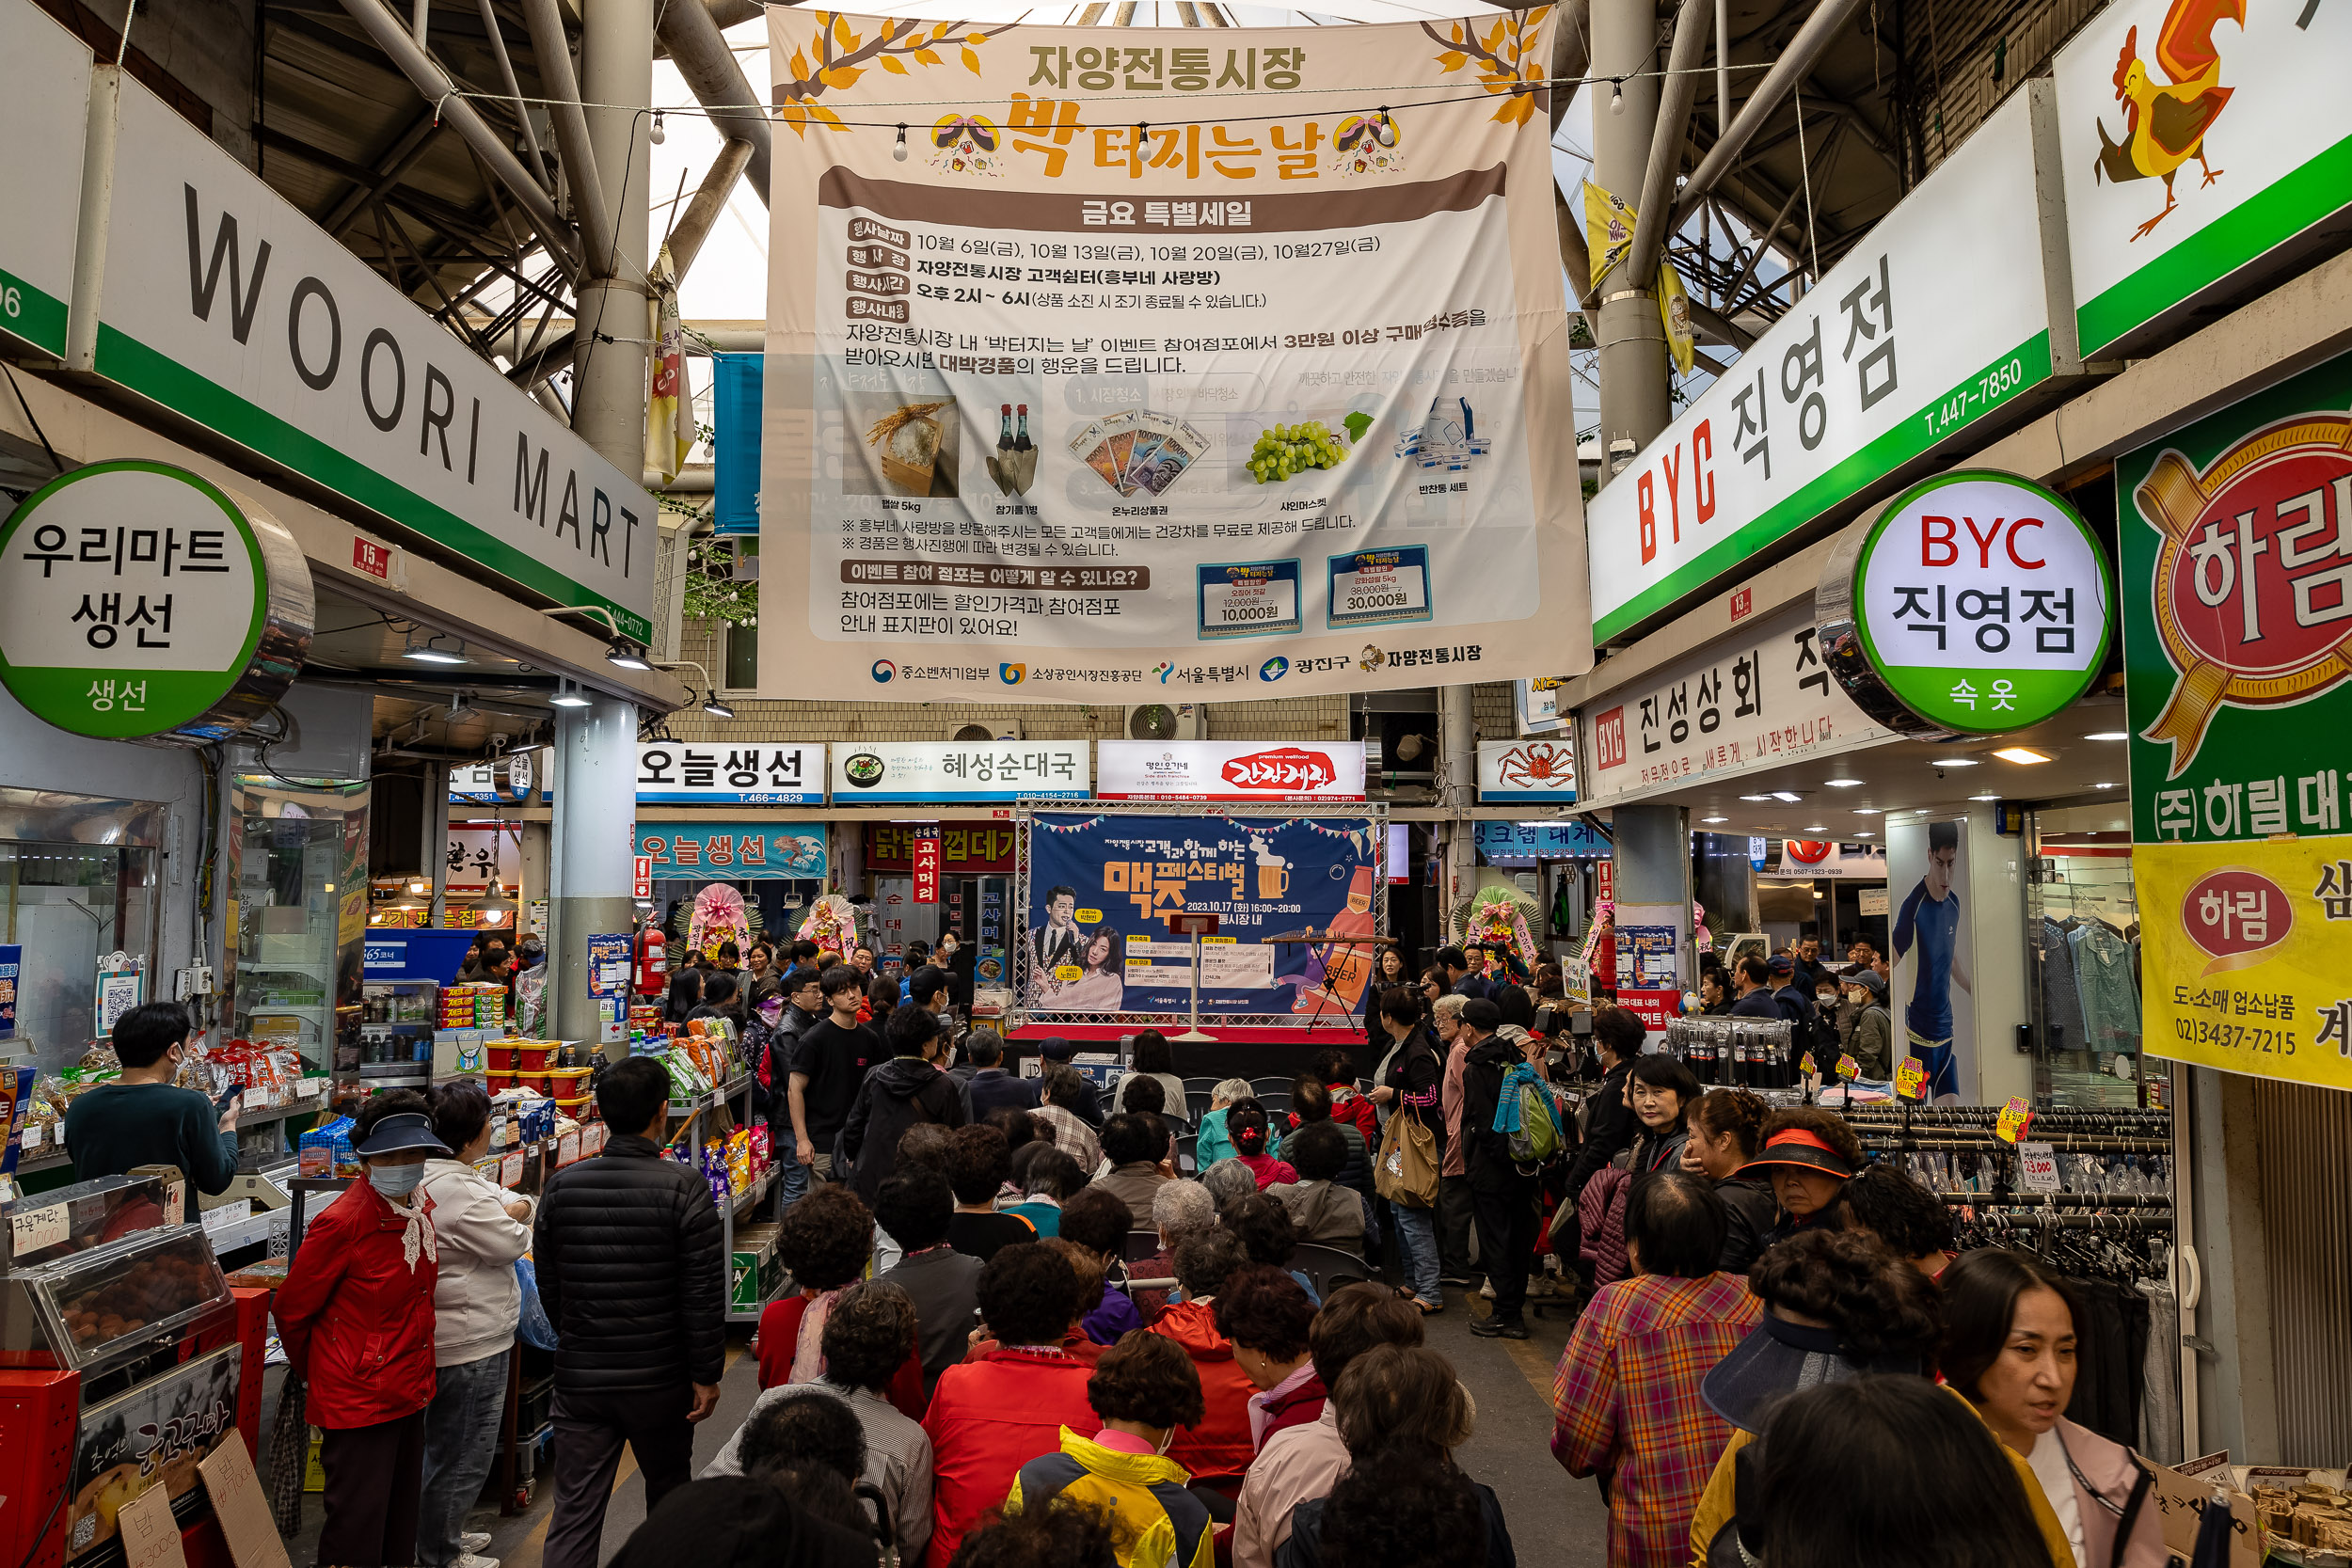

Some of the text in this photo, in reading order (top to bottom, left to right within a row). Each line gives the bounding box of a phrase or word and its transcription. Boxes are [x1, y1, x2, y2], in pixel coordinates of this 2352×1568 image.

[1028, 45, 1306, 90] 자양전통시장
[1007, 91, 1326, 180] 박 터지는 날
[1081, 199, 1252, 227] 금요 특별세일
[852, 220, 905, 246] 행사날짜
[917, 234, 1268, 263] 10월 6일(금), 10월 13일(금), 10월 20일(금),
[852, 274, 905, 292] 행사시간
[916, 260, 1023, 281] 자양전통시장
[1162, 270, 1220, 286] 사랑방)
[917, 282, 950, 301] 오후
[954, 288, 982, 303] 2시
[1067, 293, 1094, 309] 소진
[1098, 293, 1111, 309] 시
[1114, 293, 1141, 309] 조기
[1145, 294, 1185, 309] 종료될
[1188, 294, 1202, 309] 수
[1205, 293, 1267, 309] 있습니다.)
[852, 299, 905, 320] 행사내용
[846, 324, 1379, 353] 자양전통시장 내 이벤트 참여점포에서 3만원 이상
[939, 353, 1035, 375] 대박경품의
[1041, 356, 1099, 374] 행운을
[1104, 356, 1186, 374] 드립니다.
[183, 181, 484, 485] WOORI
[513, 430, 640, 580] MART
[1636, 252, 1899, 567] BYC 직영점
[1925, 357, 2023, 439] T.447-7850
[1419, 482, 1469, 496] 반찬통 세트
[901, 500, 922, 513] 5kg
[995, 505, 1024, 515] 참기름
[1111, 504, 1168, 516] 온누리상품권
[859, 514, 1357, 540] 흥부네 사랑방을 방문해주시는 모든 고객들에게는 건강차를 무료로 제공해 드립니다.
[22, 523, 230, 579] 우리마트
[362, 544, 375, 565] 15
[859, 536, 1120, 557] 경품은 행사진행에 따라 변경될 수 있습니다.
[1920, 515, 2048, 570] BYC
[2189, 470, 2352, 646] 하림
[850, 563, 1138, 586] 이벤트 참여 점포는 어떻게 알 수 있나요?
[840, 590, 1121, 616] 참여점포에는 할인가격과 참여점포
[1221, 605, 1279, 622] 10,000원
[1346, 593, 1407, 610] 30,000원
[1735, 594, 1745, 612] 13
[70, 592, 174, 650] 생선
[840, 614, 1018, 638] 안내 표지판이 있어요!
[1891, 584, 2076, 655] 직영점
[1294, 655, 1352, 674] 광진구
[1387, 643, 1483, 669] 자양전통시장
[901, 664, 991, 681] 중소벤처기업부
[1032, 667, 1143, 684] 소상공인시장진흥공단
[1176, 663, 1250, 684] 서울특별시
[86, 678, 148, 714] 생선
[1639, 649, 1761, 754] 진성상회
[1597, 717, 1624, 766] BYC
[637, 749, 802, 787] 오늘생선
[942, 752, 1076, 782] 혜성순대국
[1228, 760, 1329, 792] 간장게장
[739, 793, 803, 803] T.466-4829
[914, 826, 939, 838] 순대국
[1549, 825, 1595, 845] 대게
[642, 834, 767, 866] 오늘생선
[1144, 839, 1184, 860] 고객과
[1184, 838, 1217, 860] 함께
[1217, 838, 1246, 861] 하는
[917, 840, 936, 901] 고사머리
[1104, 860, 1245, 927] 맥주 페스티벌
[1351, 896, 1367, 907] BEER
[1187, 901, 1232, 912] 2023.10.17
[1249, 903, 1301, 913] 16:00~20:00
[1251, 912, 1263, 926] 내
[2199, 888, 2268, 942] 하림
[1326, 963, 1357, 984] BEER
[2233, 990, 2296, 1022] 업소납품
[2176, 1017, 2297, 1056] 02)3437-7215
[1904, 1056, 1922, 1073] SALE
[2009, 1097, 2029, 1114] SALE
[14, 1208, 59, 1233] 구운계란
